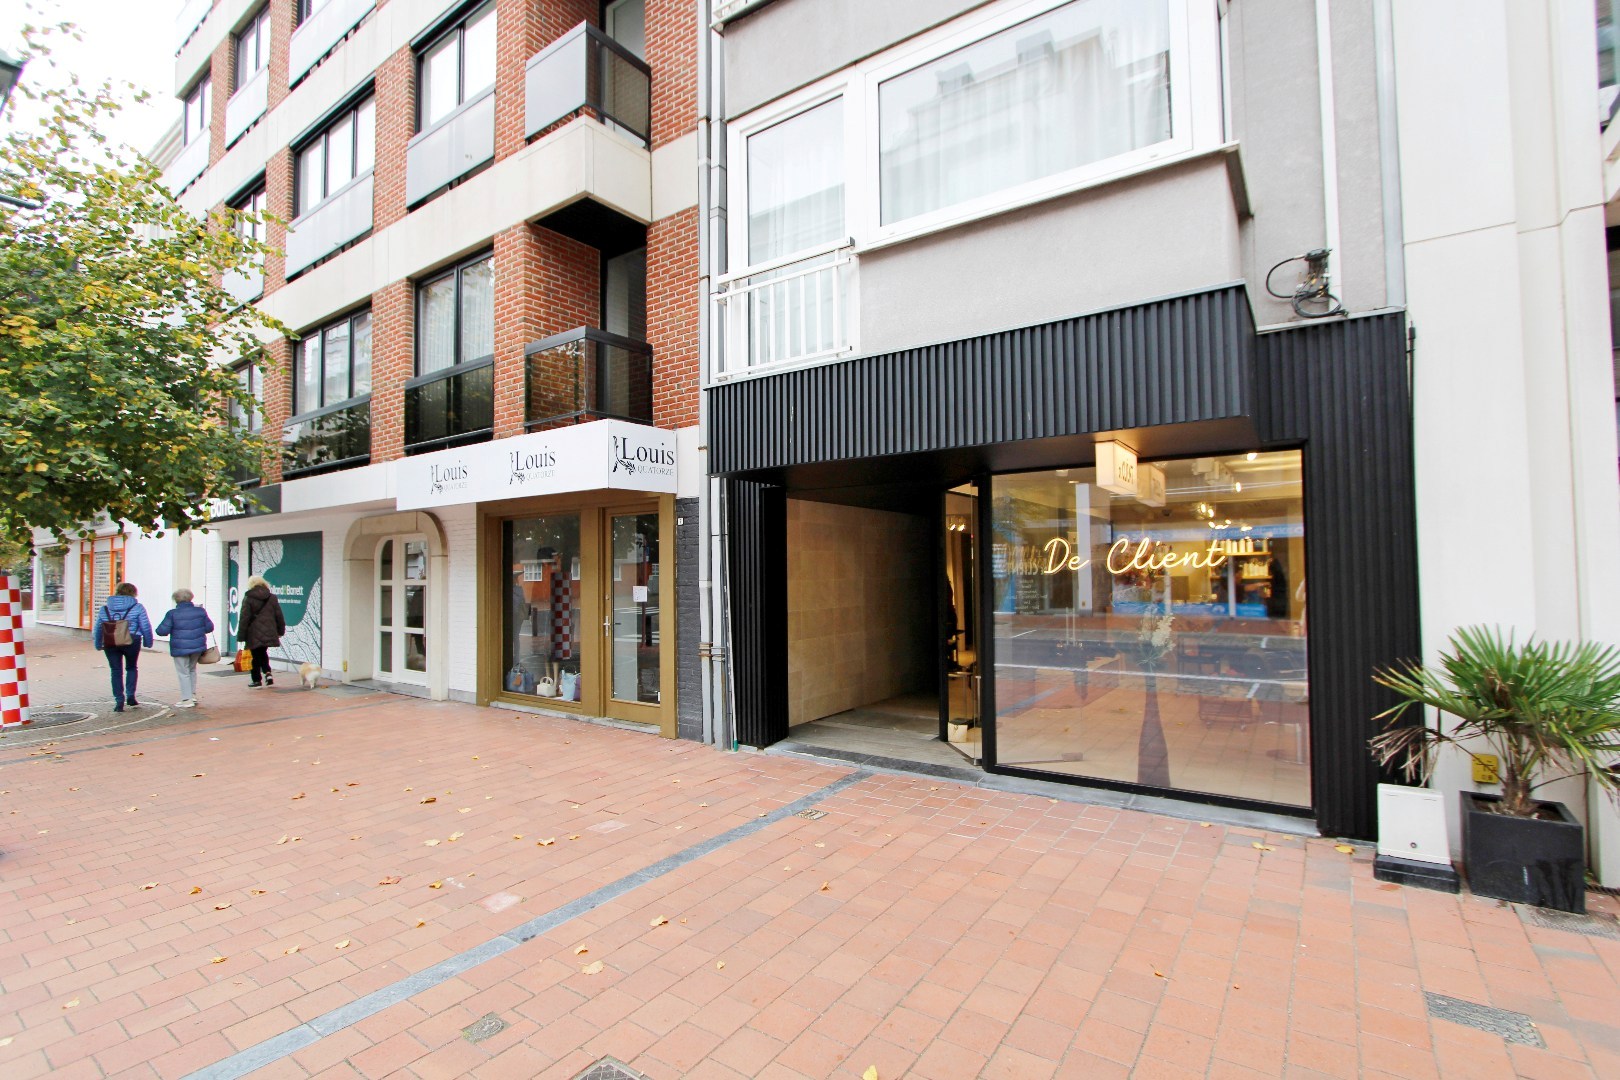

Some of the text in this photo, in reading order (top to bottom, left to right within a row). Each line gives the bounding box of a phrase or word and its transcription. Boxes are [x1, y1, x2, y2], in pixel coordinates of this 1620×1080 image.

[515, 445, 556, 472] Louis
[620, 437, 675, 466] Louis
[435, 459, 468, 483] Louis
[637, 465, 674, 476] QUATORZE
[1044, 537, 1090, 574] De
[1106, 536, 1226, 575] Client
[269, 584, 284, 595] olland
